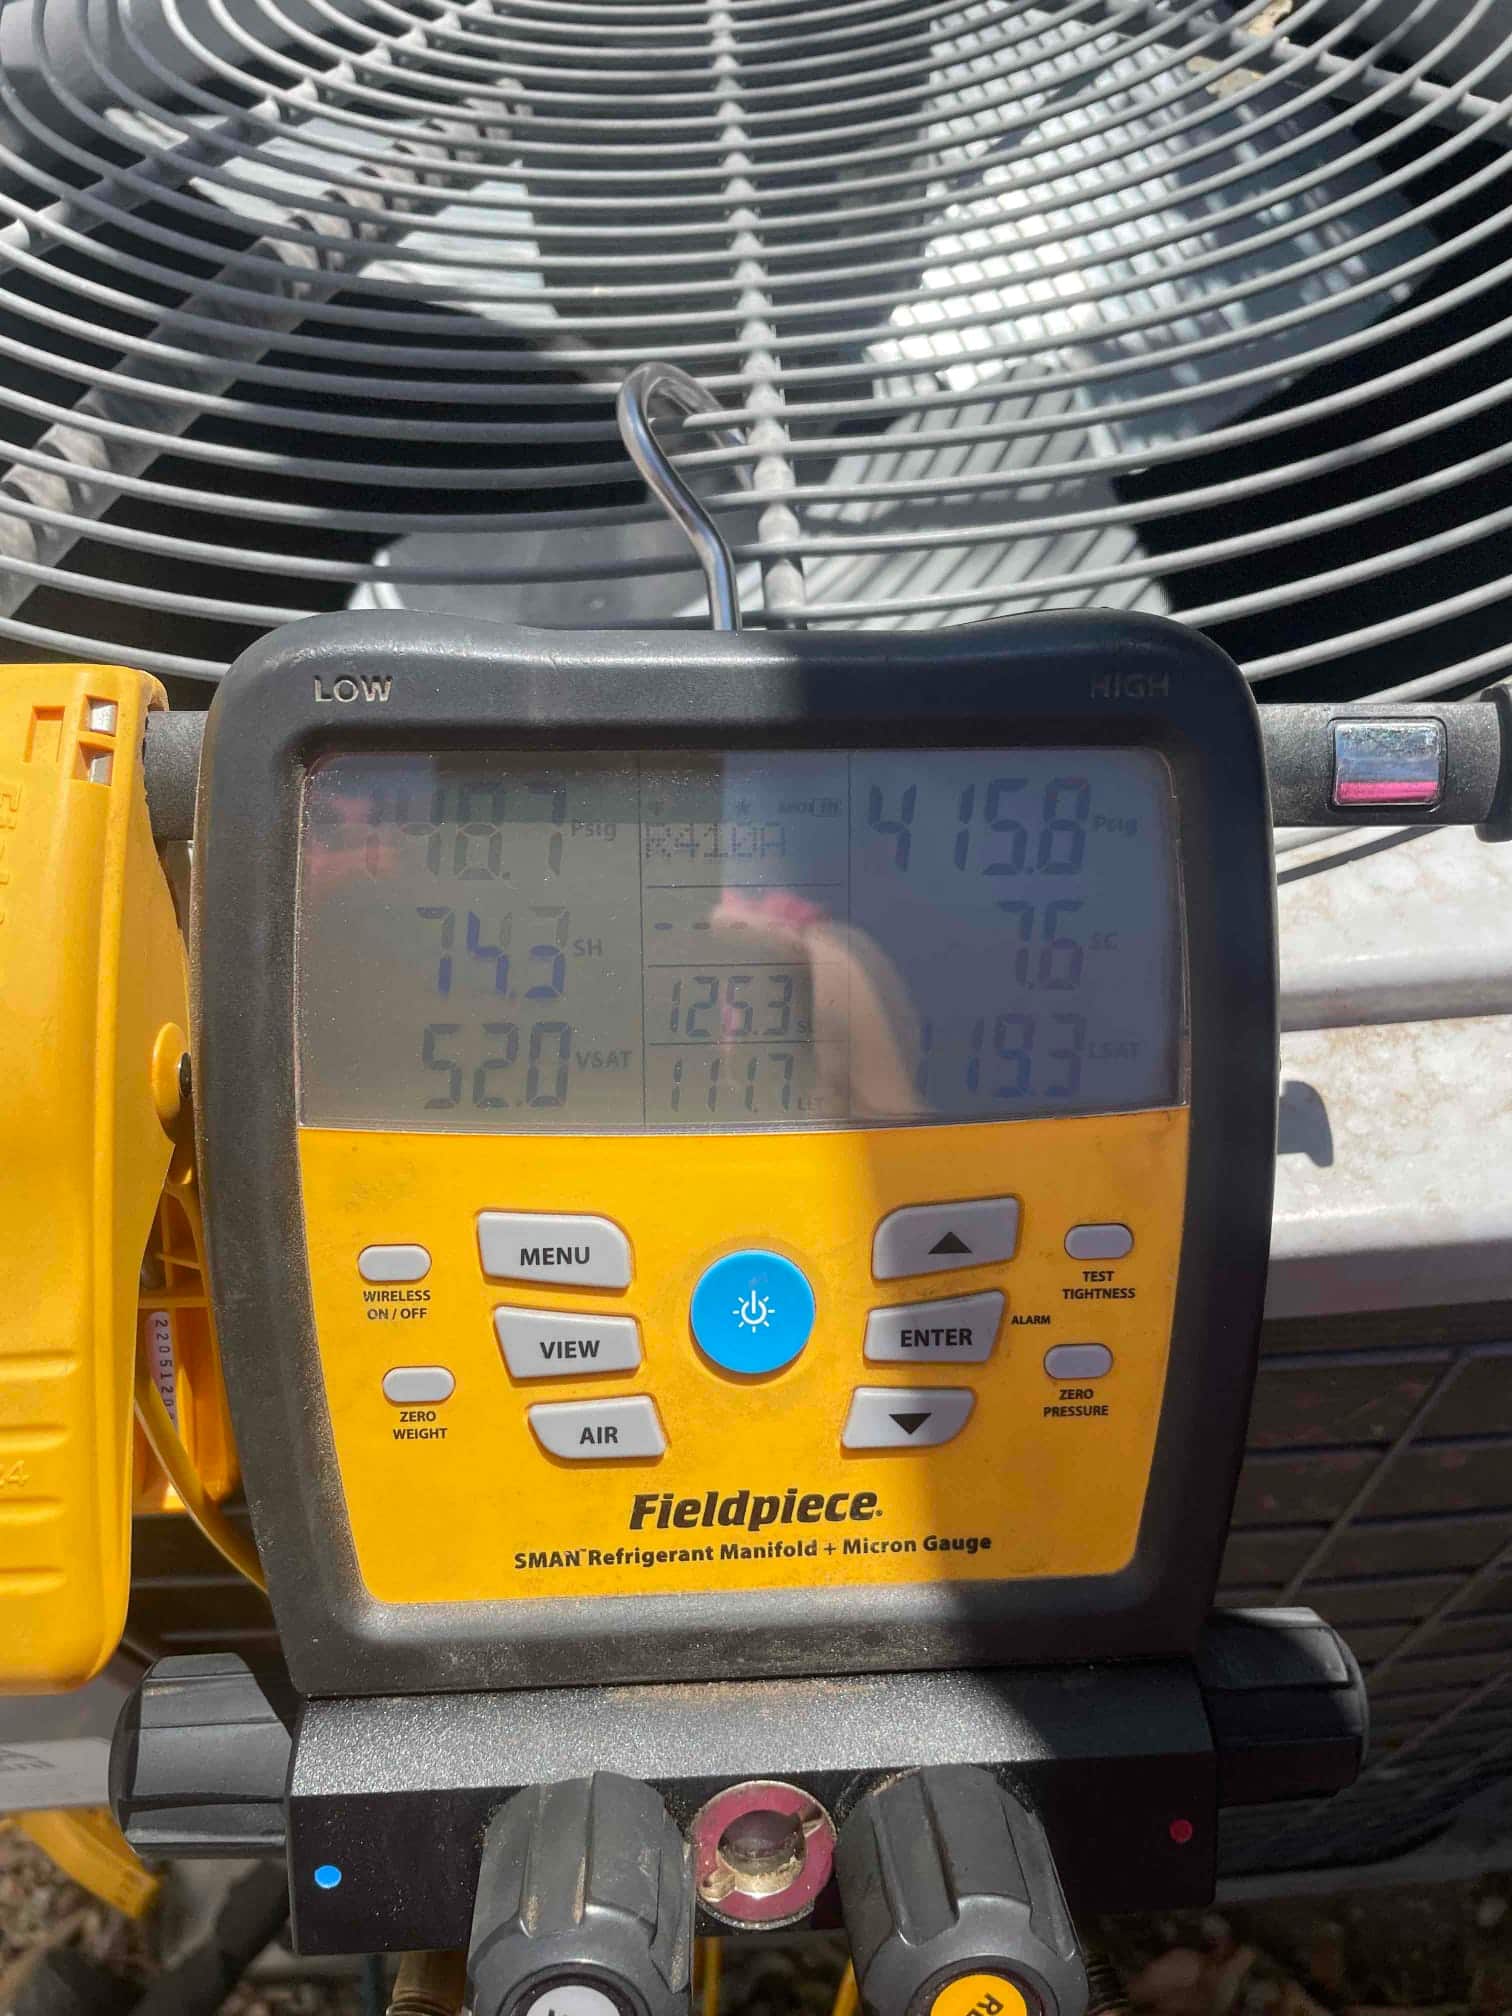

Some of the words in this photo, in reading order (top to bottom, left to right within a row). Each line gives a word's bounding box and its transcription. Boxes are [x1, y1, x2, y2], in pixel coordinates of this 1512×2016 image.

[314, 675, 394, 704] LOW
[1089, 673, 1171, 700] HIGH
[868, 777, 1091, 876] 415.8
[573, 937, 603, 958] SH
[421, 1021, 572, 1110] 52.0
[576, 1050, 633, 1071] VSAT
[519, 1246, 591, 1267] MENU
[1082, 1270, 1114, 1283] TEST
[362, 1289, 431, 1303] WIRELESS
[1062, 1287, 1136, 1300] TIGHTNESS
[367, 1308, 389, 1320] ON
[400, 1307, 428, 1319] OFF
[1011, 1314, 1051, 1326] ALARM
[899, 1328, 973, 1348] ENTER
[540, 1340, 601, 1360] VIEW
[1058, 1388, 1094, 1401] ZERO
[399, 1410, 437, 1424] ZERO
[1042, 1404, 1109, 1418] PRESSURE
[392, 1427, 448, 1441] WEIGHT
[579, 1425, 619, 1446] AIR
[588, 1545, 714, 1568] Refrigerant
[719, 1539, 817, 1560] Manifold
[823, 1542, 835, 1555] +
[842, 1536, 917, 1556] Micron
[922, 1534, 992, 1556] Gauge
